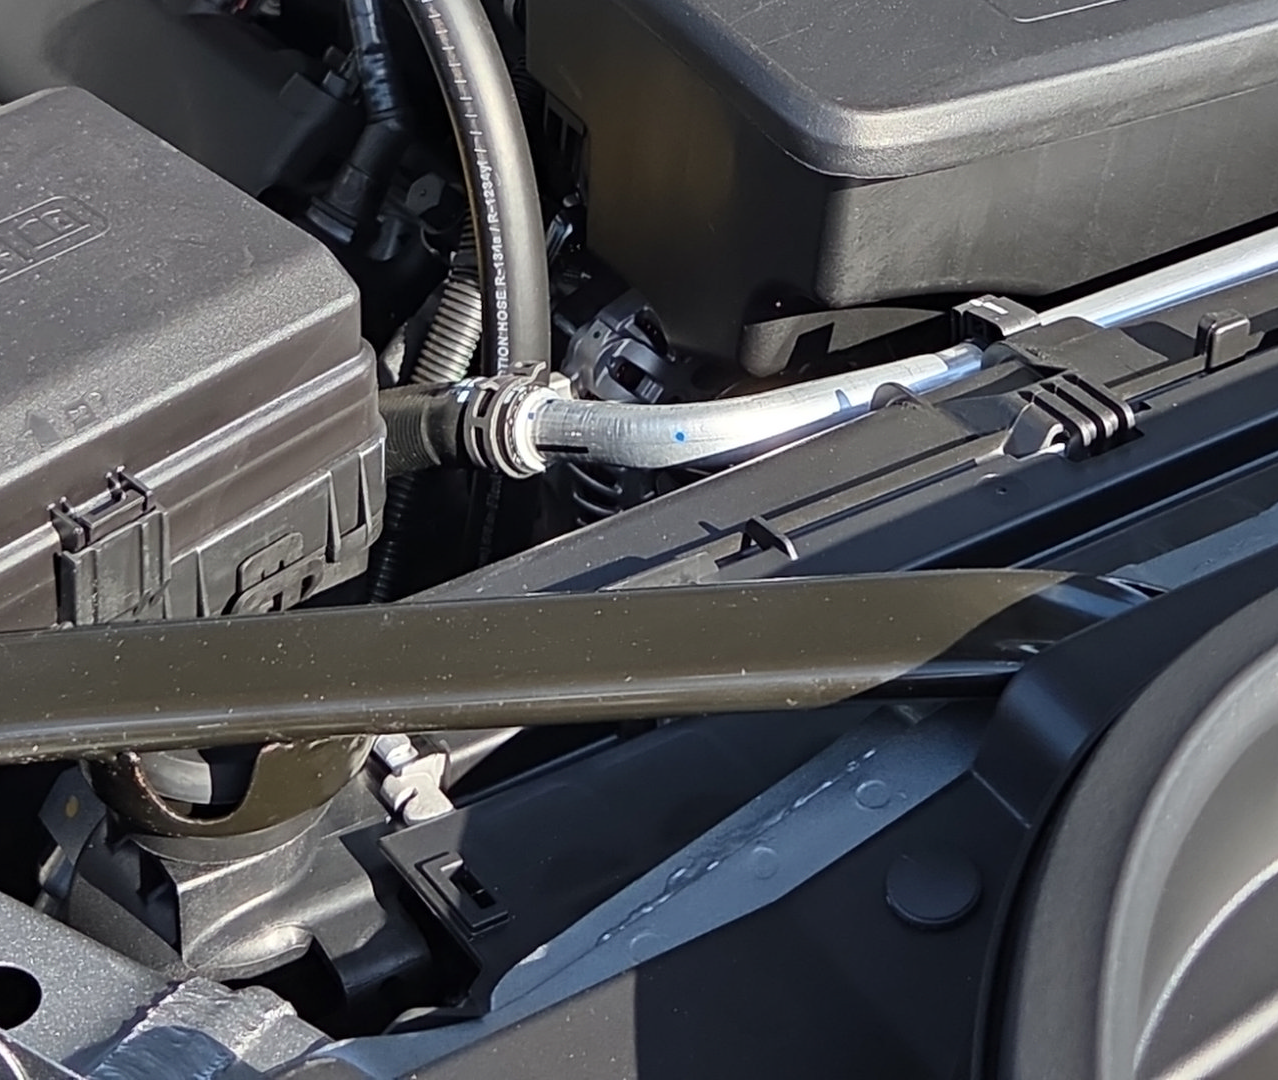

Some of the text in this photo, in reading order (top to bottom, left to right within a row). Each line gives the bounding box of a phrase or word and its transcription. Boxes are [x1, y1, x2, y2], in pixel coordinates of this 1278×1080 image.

[491, 235, 507, 287] R-134a
[495, 289, 509, 332] HOSE
[497, 333, 510, 376] TION
